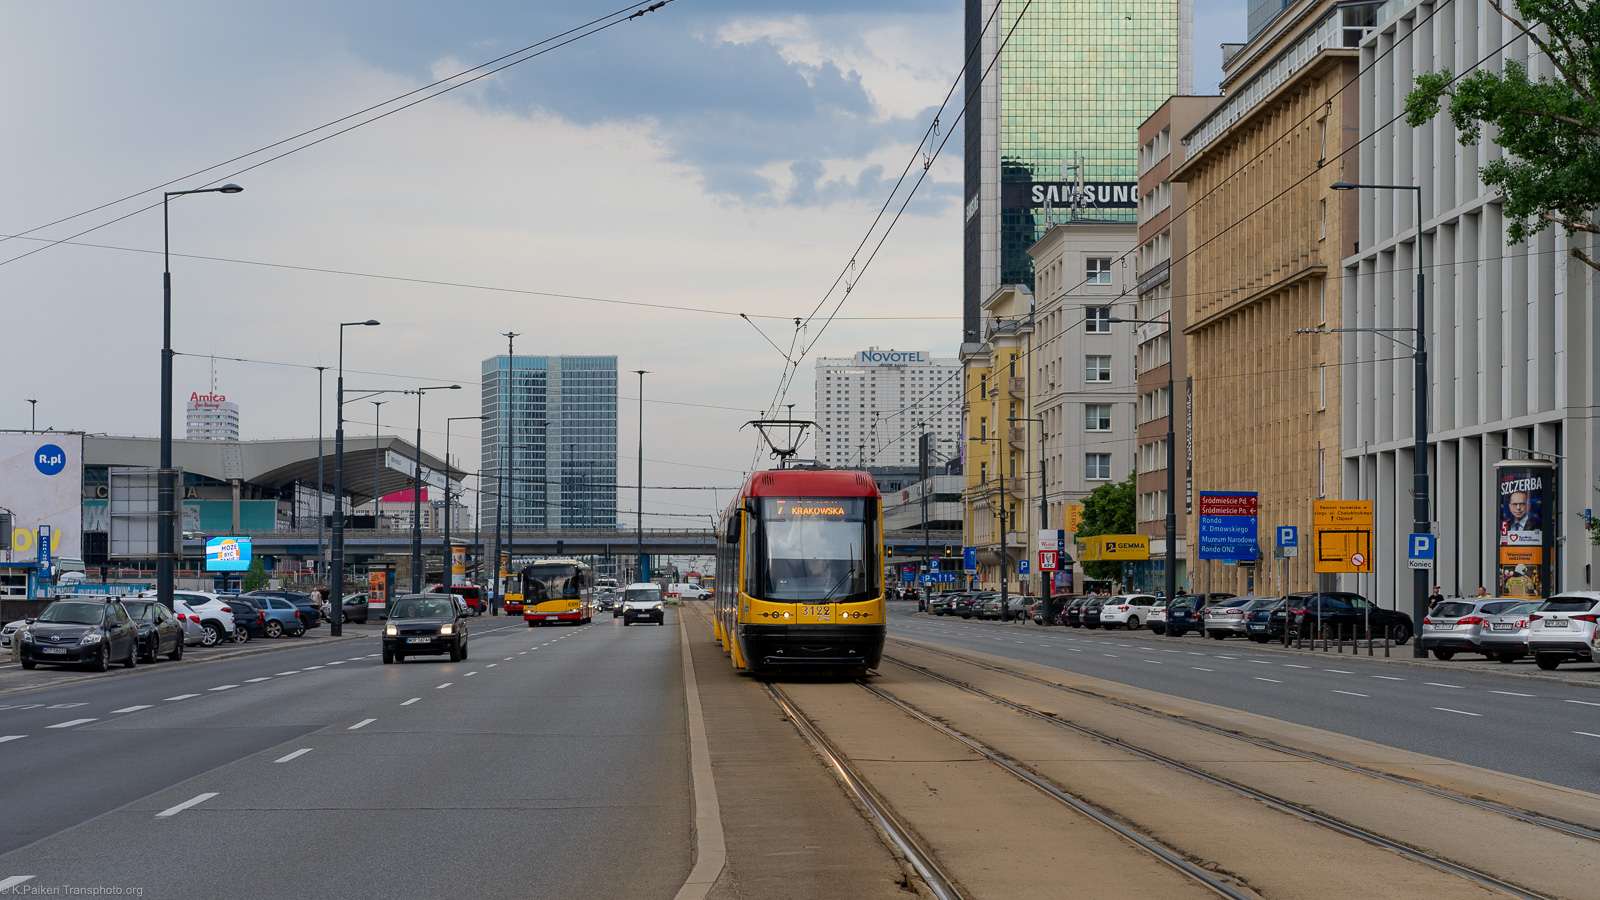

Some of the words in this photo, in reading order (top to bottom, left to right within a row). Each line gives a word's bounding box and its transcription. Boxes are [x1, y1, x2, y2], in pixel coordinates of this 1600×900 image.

[861, 351, 925, 362] NOVOTEL
[190, 392, 226, 402] Amica
[39, 454, 61, 466] R.pl
[1501, 477, 1542, 495] SZCZERBA
[791, 507, 845, 515] KRAKOWSKA
[1209, 525, 1249, 534] Dmowskiego
[1502, 521, 1507, 535] 5
[1281, 528, 1294, 545] P
[1414, 536, 1430, 556] P
[802, 606, 831, 616] 3122
